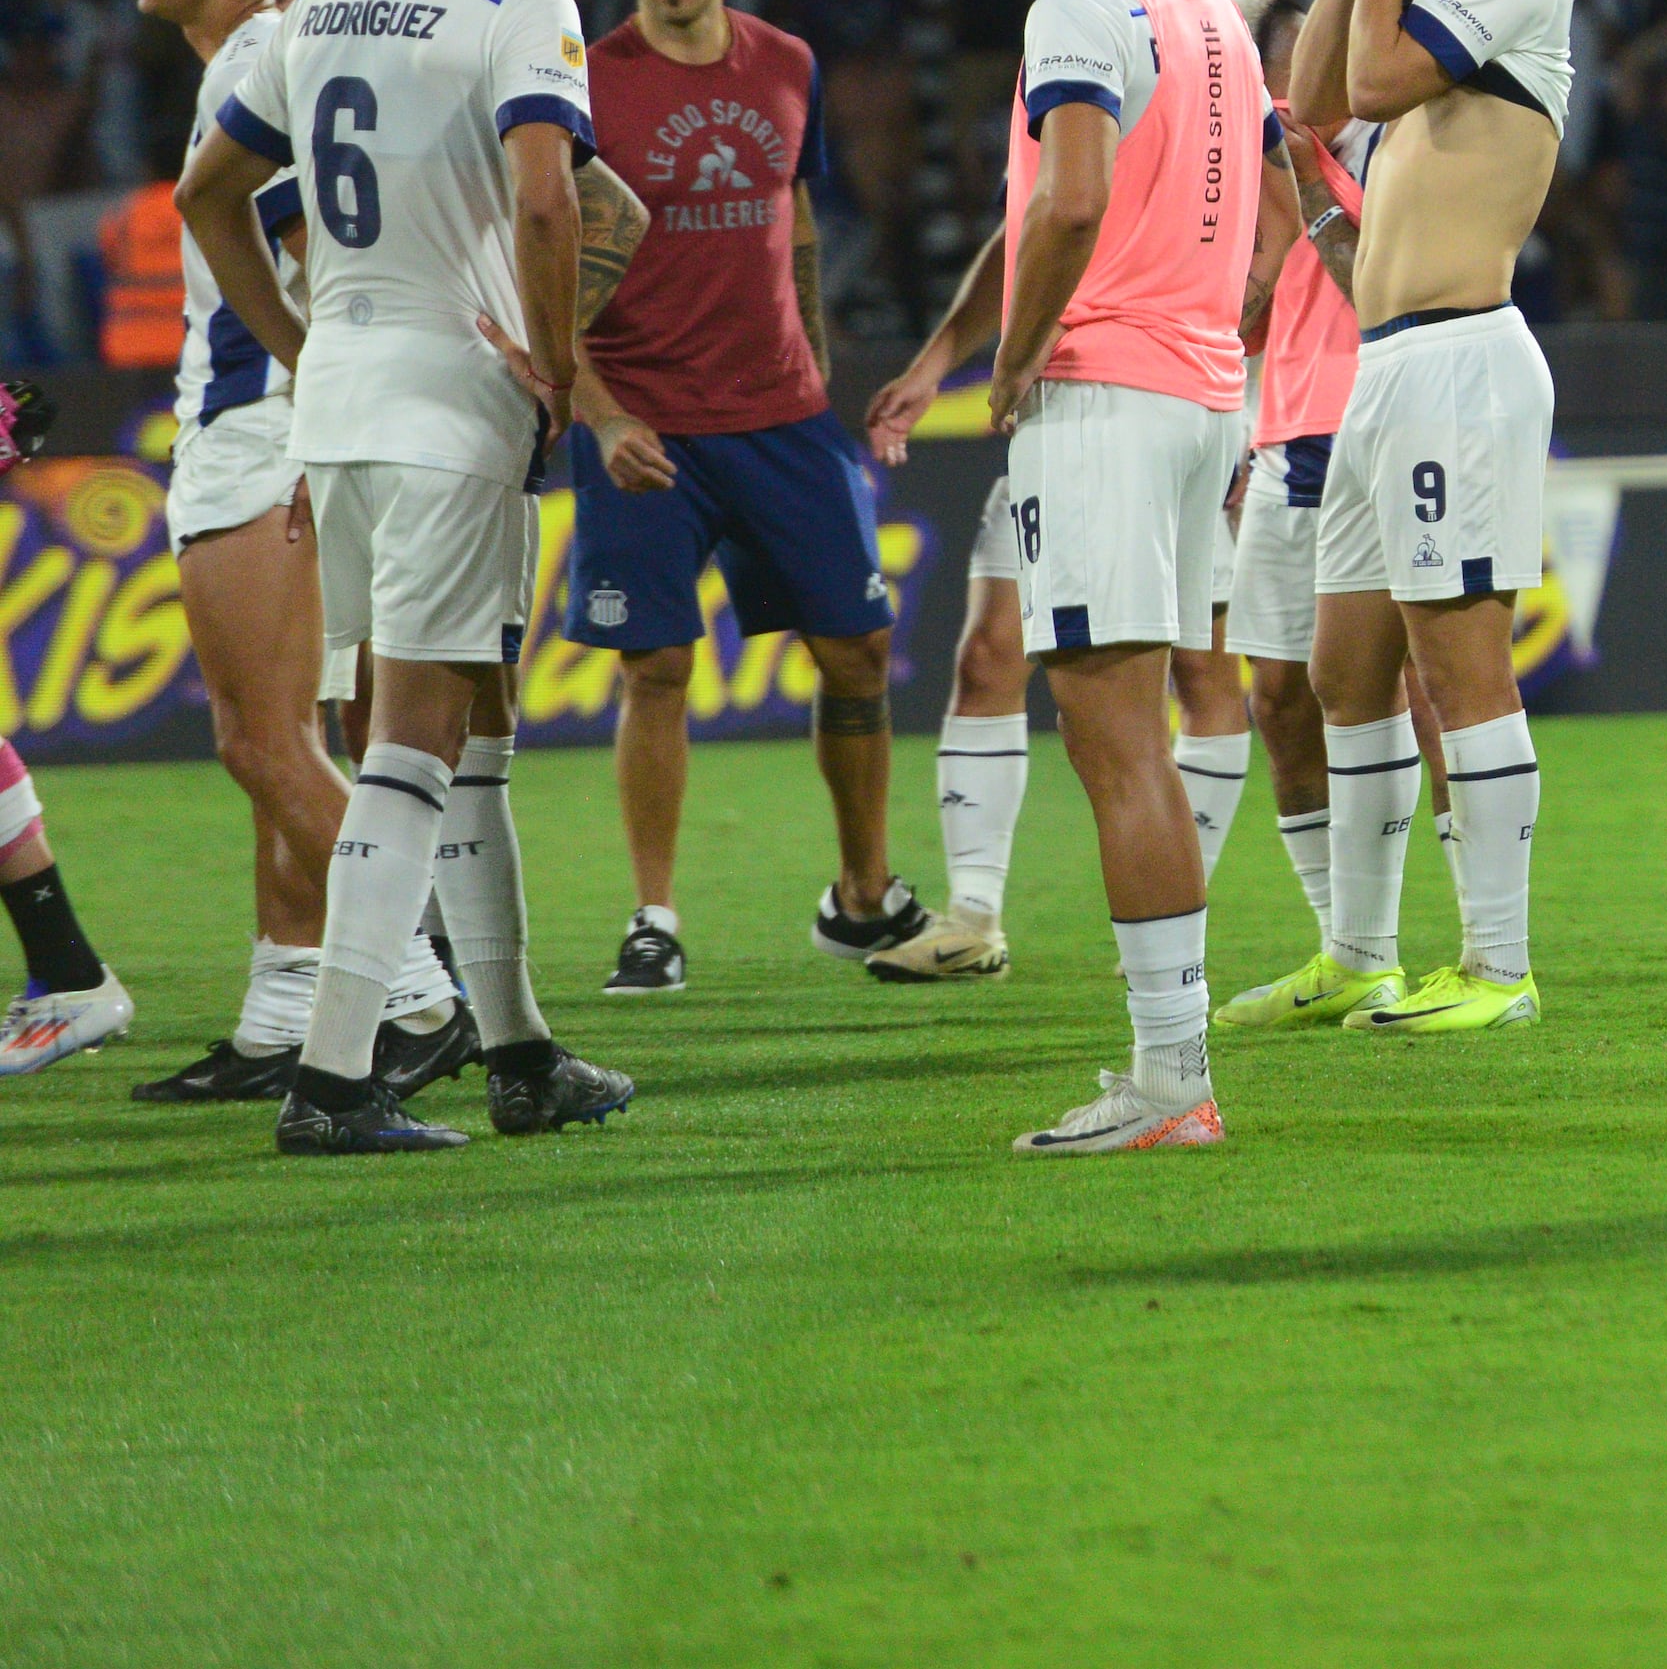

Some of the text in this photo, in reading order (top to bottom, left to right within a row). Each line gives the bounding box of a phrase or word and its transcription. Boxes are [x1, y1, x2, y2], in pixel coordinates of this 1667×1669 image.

[298, 0, 448, 40] RODRIGUEZ
[656, 103, 708, 149] COQ
[1200, 19, 1223, 244] LE COQ SPORTIF
[312, 75, 382, 249] 6
[646, 149, 677, 181] LE
[664, 198, 777, 233] TALLERES
[1412, 460, 1447, 523] 9
[1010, 495, 1041, 572] 18
[1381, 815, 1414, 837] GB
[435, 839, 485, 860] BT
[1182, 963, 1204, 986] GB
